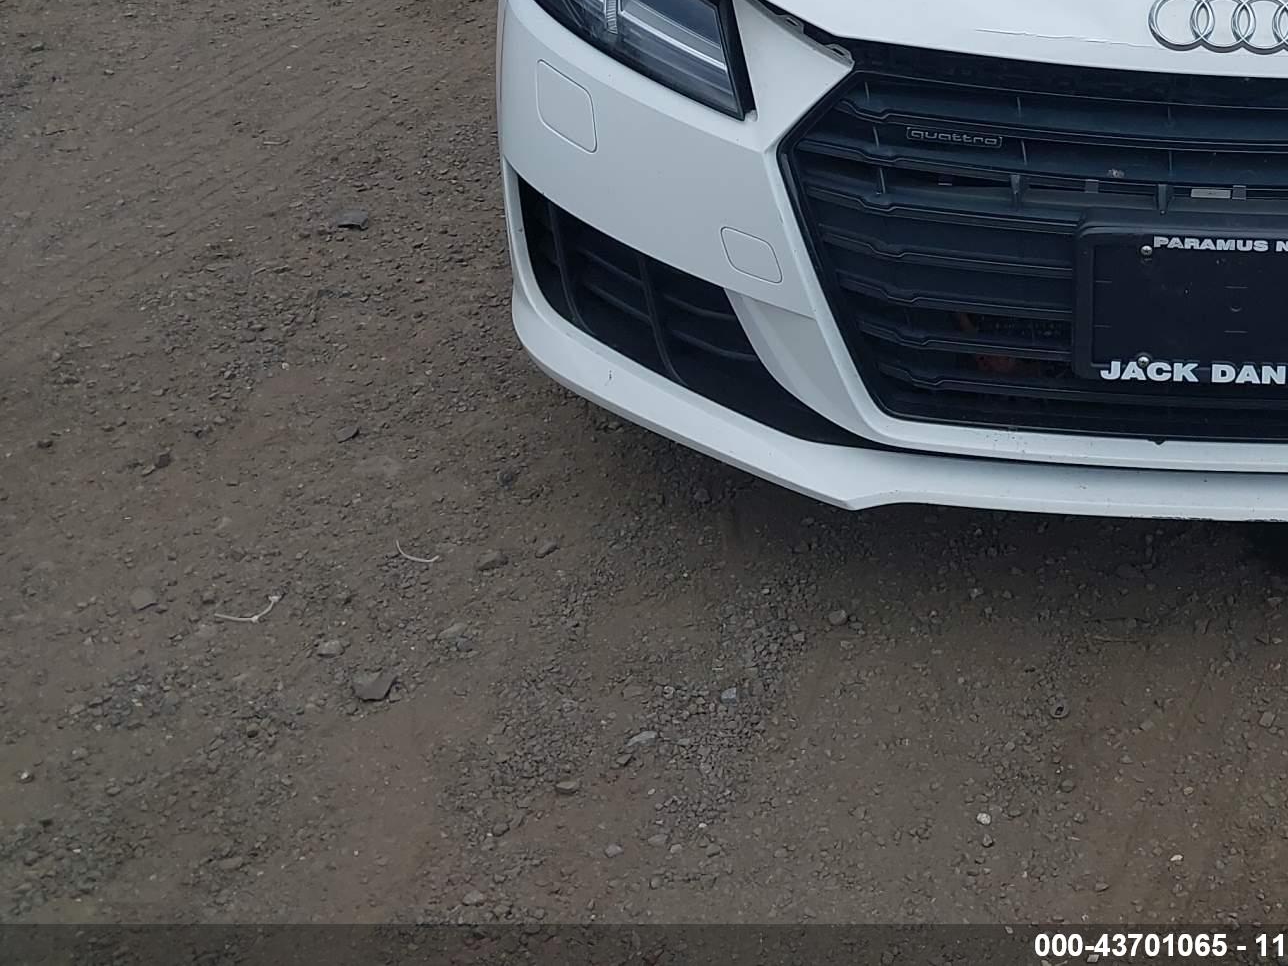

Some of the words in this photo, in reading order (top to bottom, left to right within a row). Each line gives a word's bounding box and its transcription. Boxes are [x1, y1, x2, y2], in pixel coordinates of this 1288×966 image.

[911, 130, 998, 145] quattro
[1153, 236, 1269, 252] PARAMUS
[1100, 361, 1199, 383] JACK
